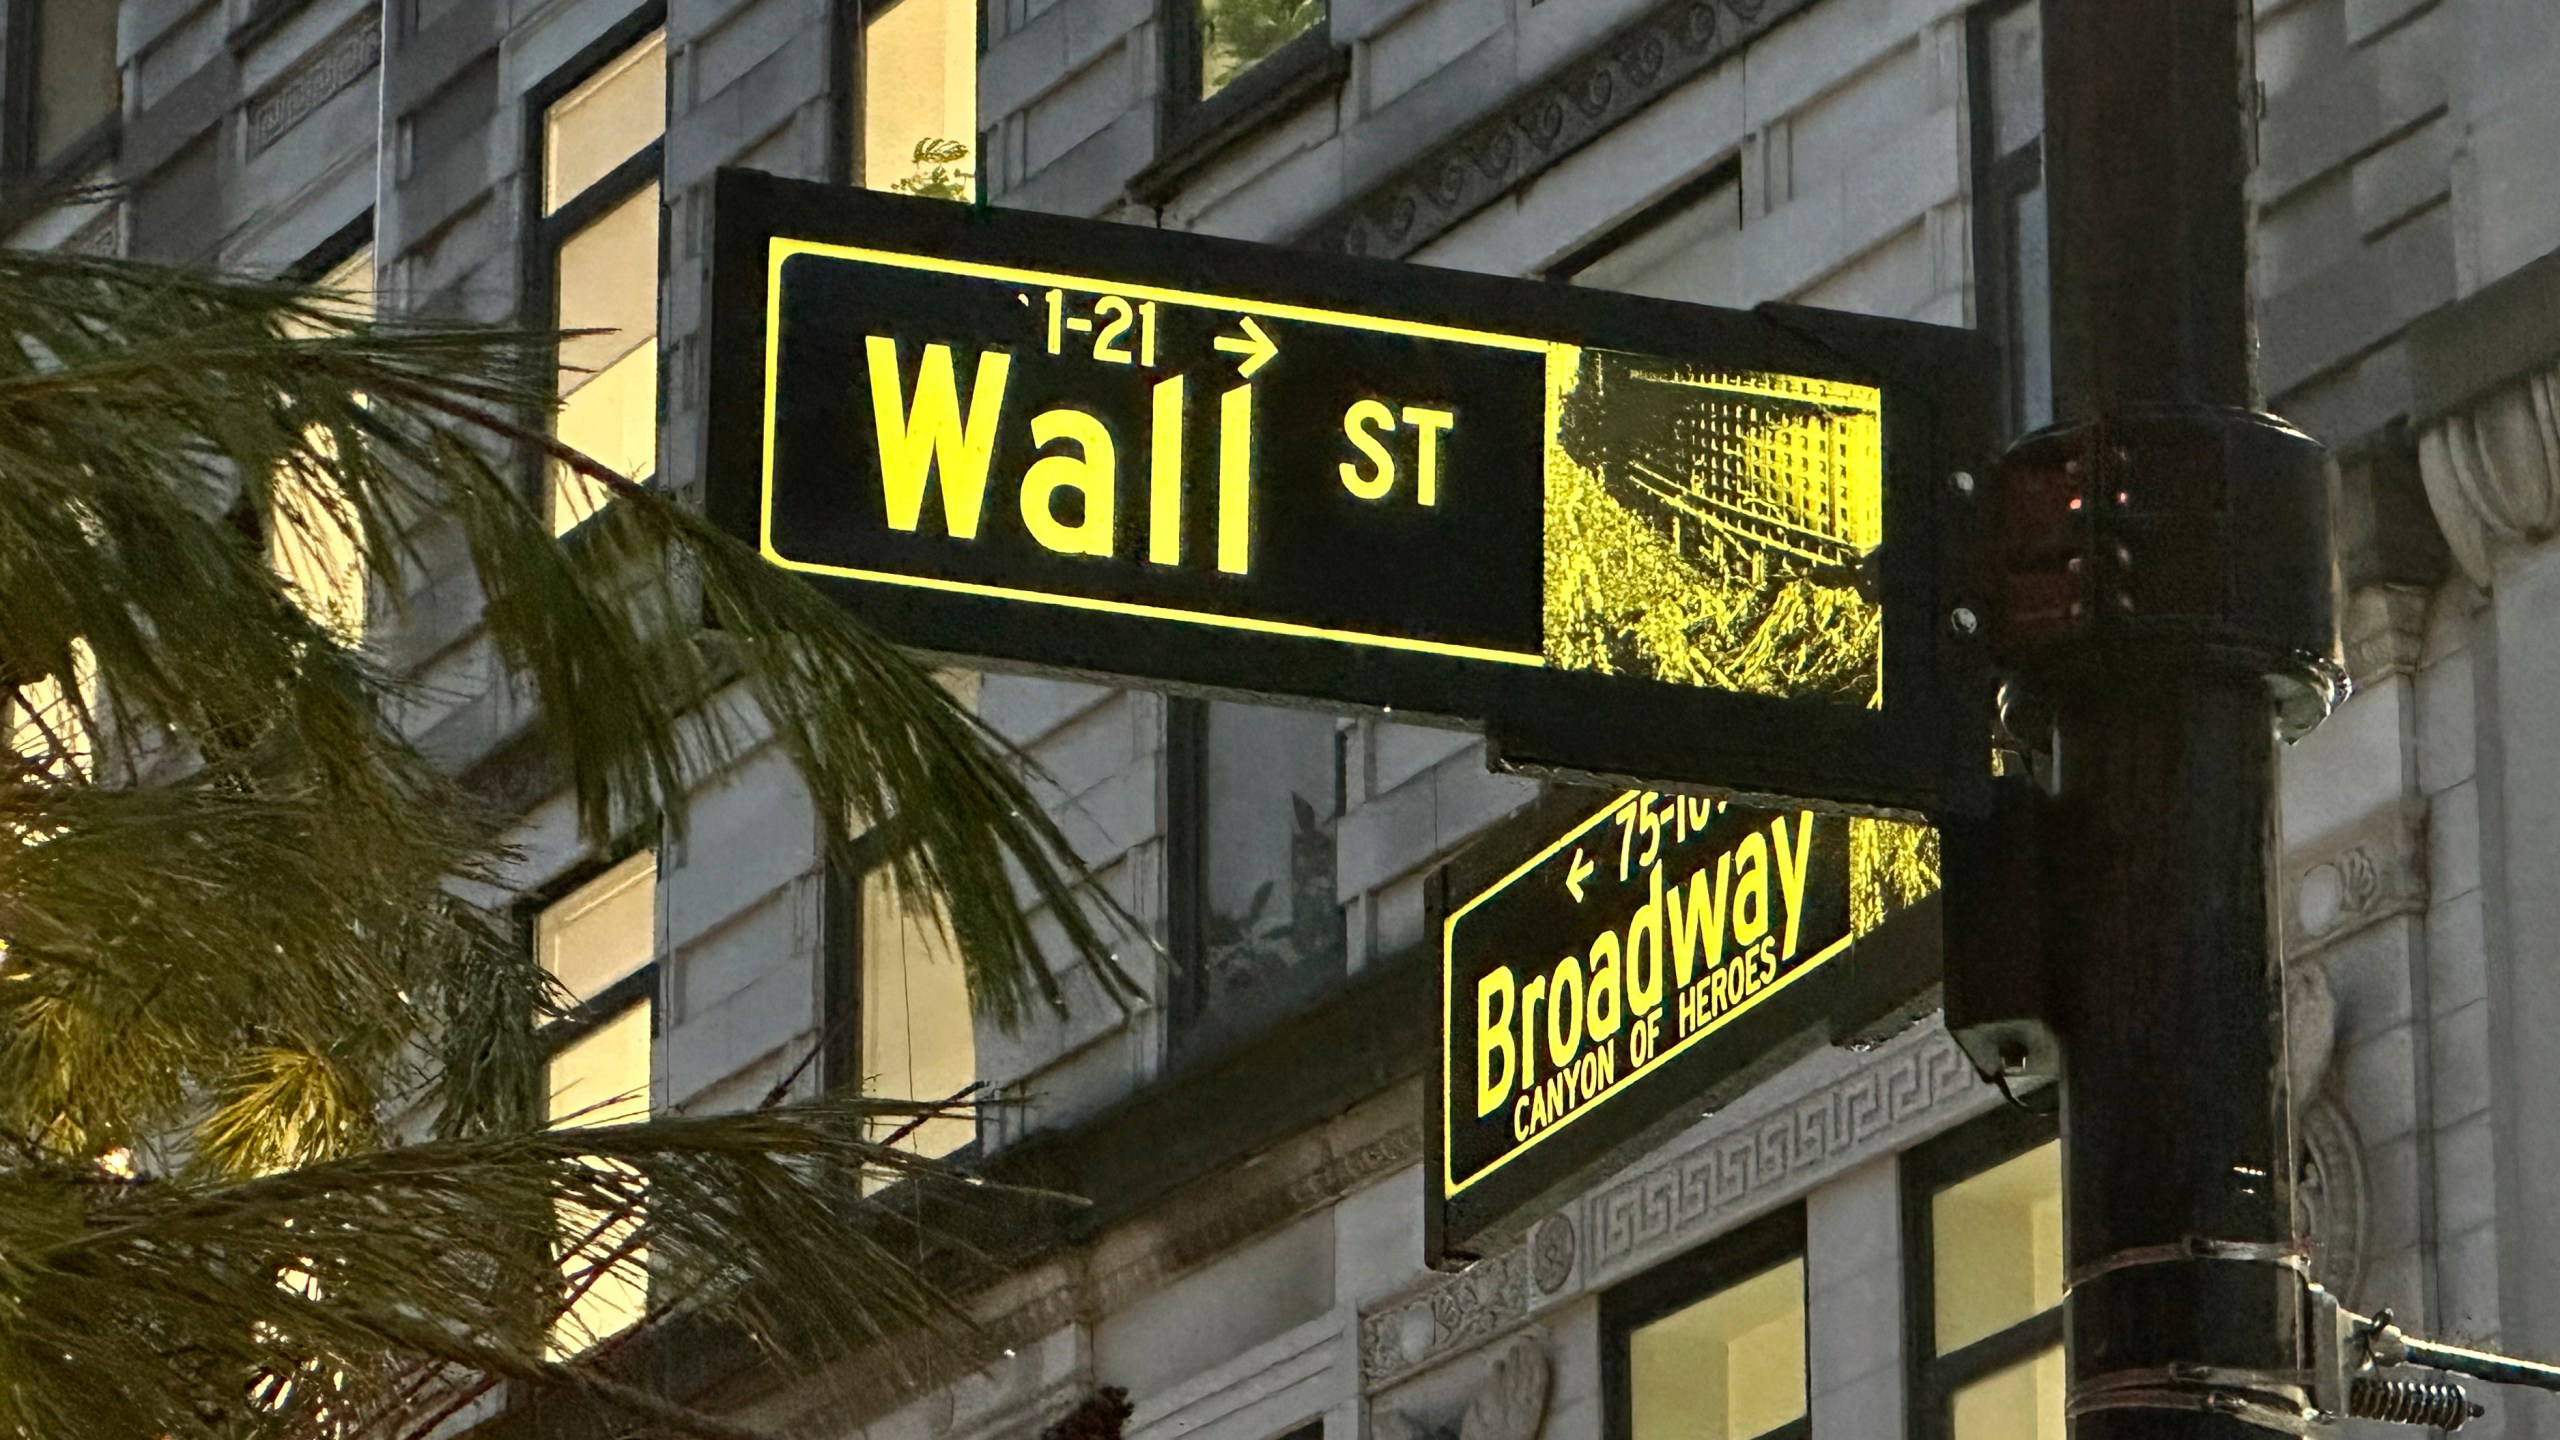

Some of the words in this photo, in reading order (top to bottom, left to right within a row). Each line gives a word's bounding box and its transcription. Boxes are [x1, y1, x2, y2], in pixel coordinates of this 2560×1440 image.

[1045, 288, 1156, 368] 1-21
[864, 335, 1252, 575] Wall
[1338, 399, 1454, 508] ST
[1477, 809, 1815, 1118] Broadway
[1513, 1038, 1615, 1142] CANYON
[1629, 1006, 1663, 1068] OF
[1678, 935, 1777, 1038] HEROES
